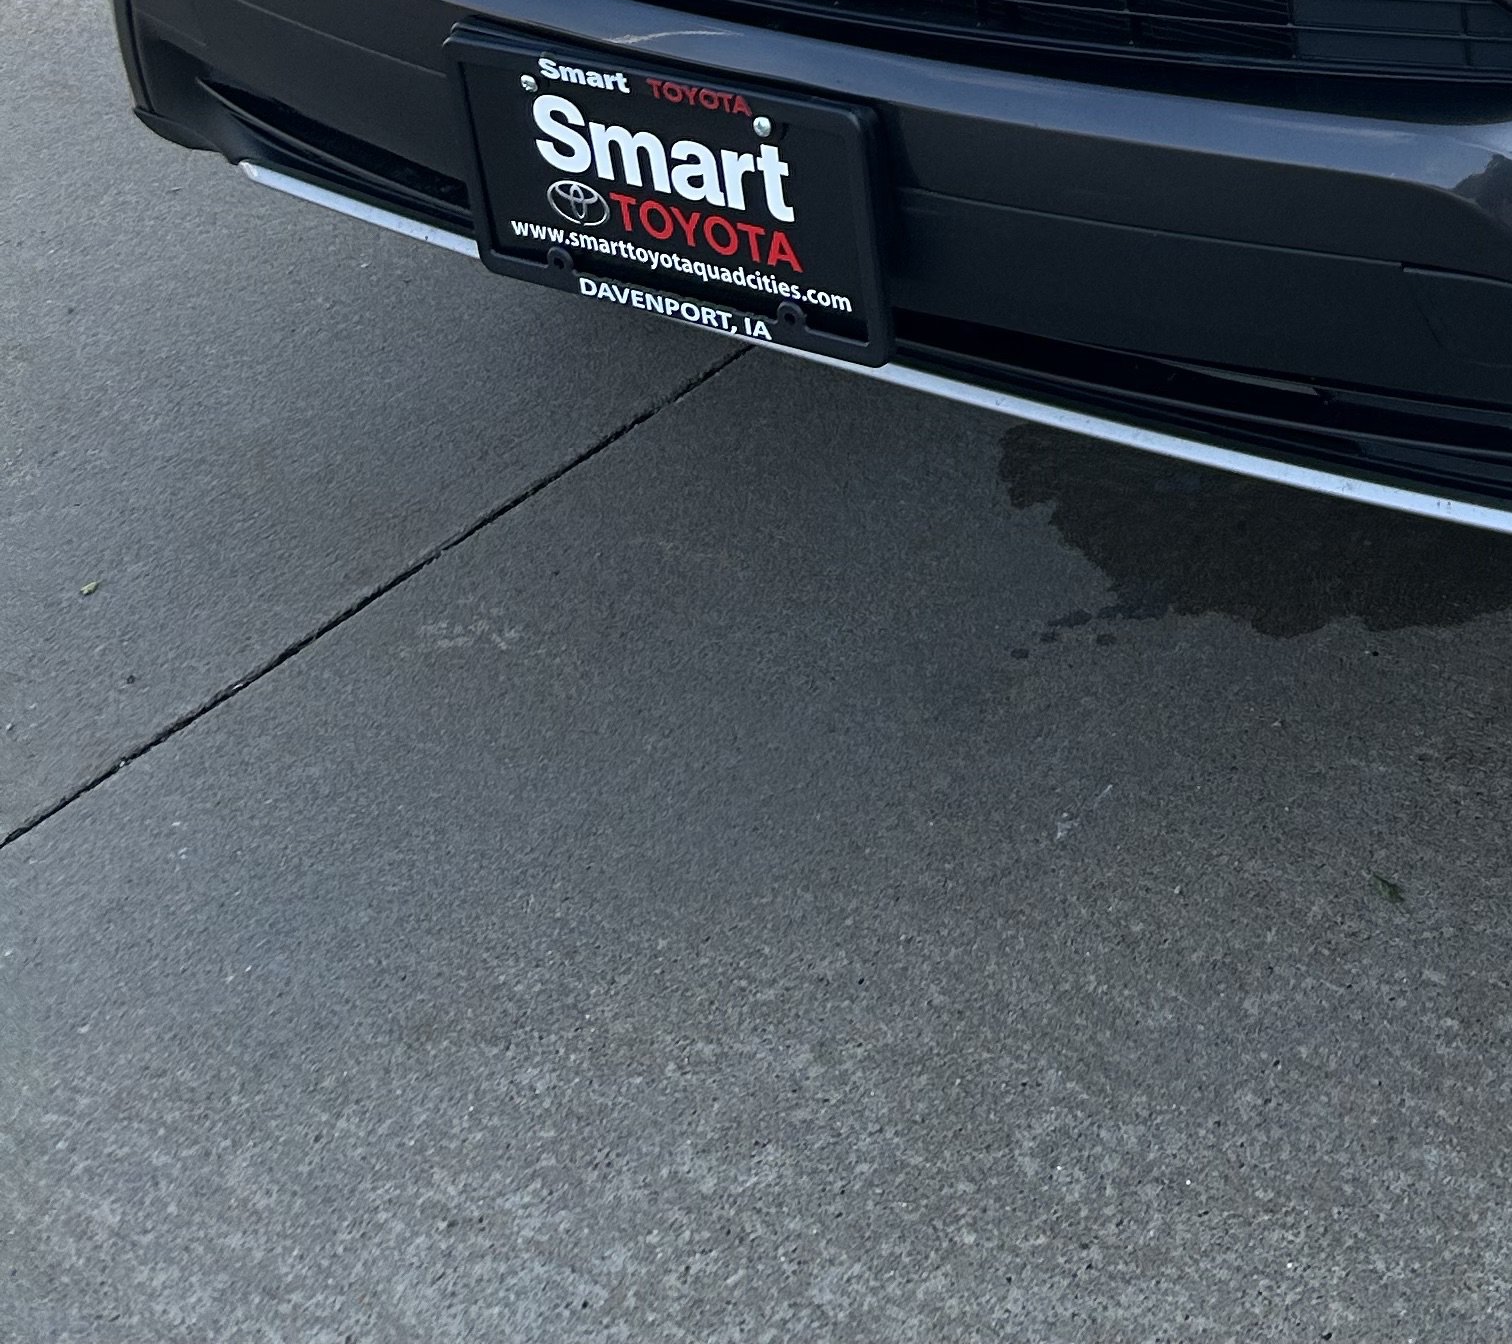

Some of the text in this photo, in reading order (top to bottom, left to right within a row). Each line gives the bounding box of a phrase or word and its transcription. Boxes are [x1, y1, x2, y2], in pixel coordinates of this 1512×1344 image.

[537, 57, 752, 116] Smart TOYOTA
[532, 94, 795, 223] Smart
[510, 220, 853, 313] www.smarttoyotaquadcities.com
[608, 191, 804, 273] TOYOTA
[579, 277, 773, 341] DAVENPORT, IA
